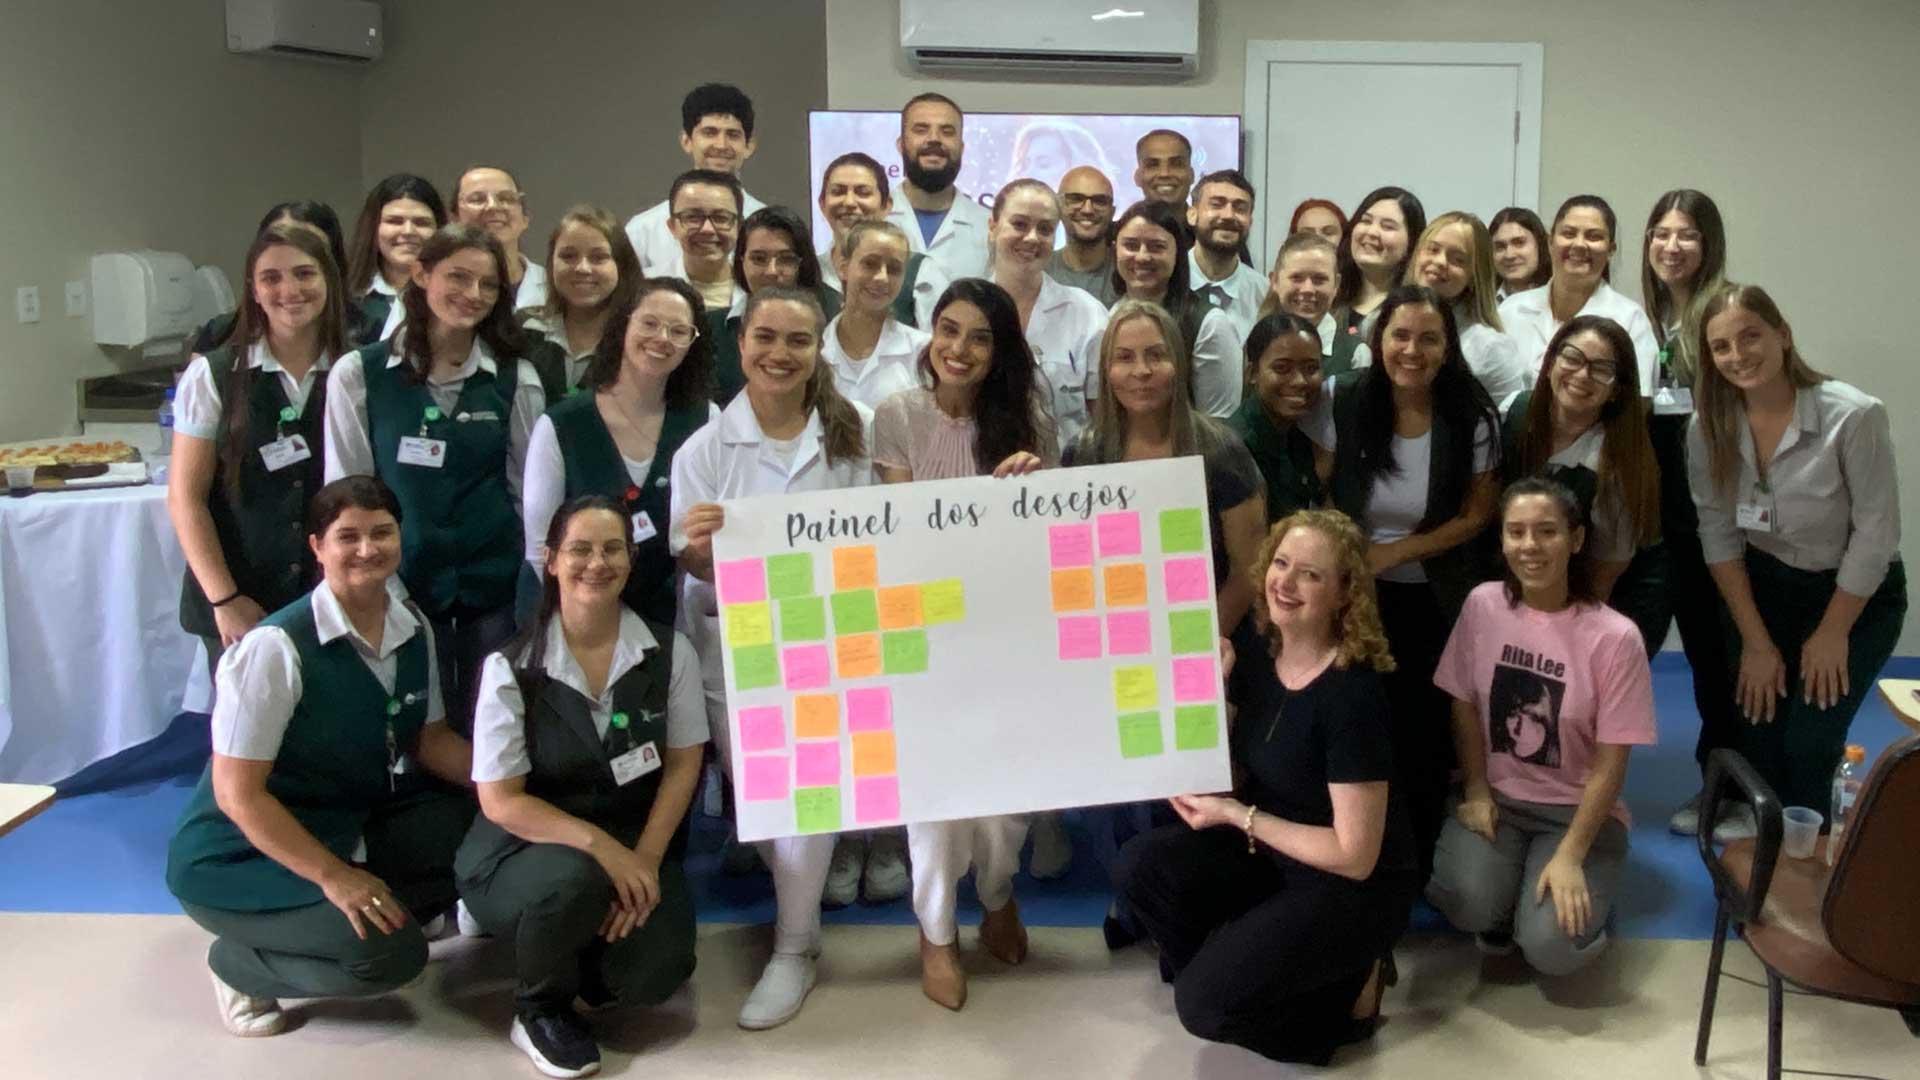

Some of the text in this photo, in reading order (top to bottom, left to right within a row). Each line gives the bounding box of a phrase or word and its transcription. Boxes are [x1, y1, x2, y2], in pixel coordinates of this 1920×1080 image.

[786, 482, 1136, 548] Painel dos desejos
[1501, 643, 1565, 678] Rita Lee
